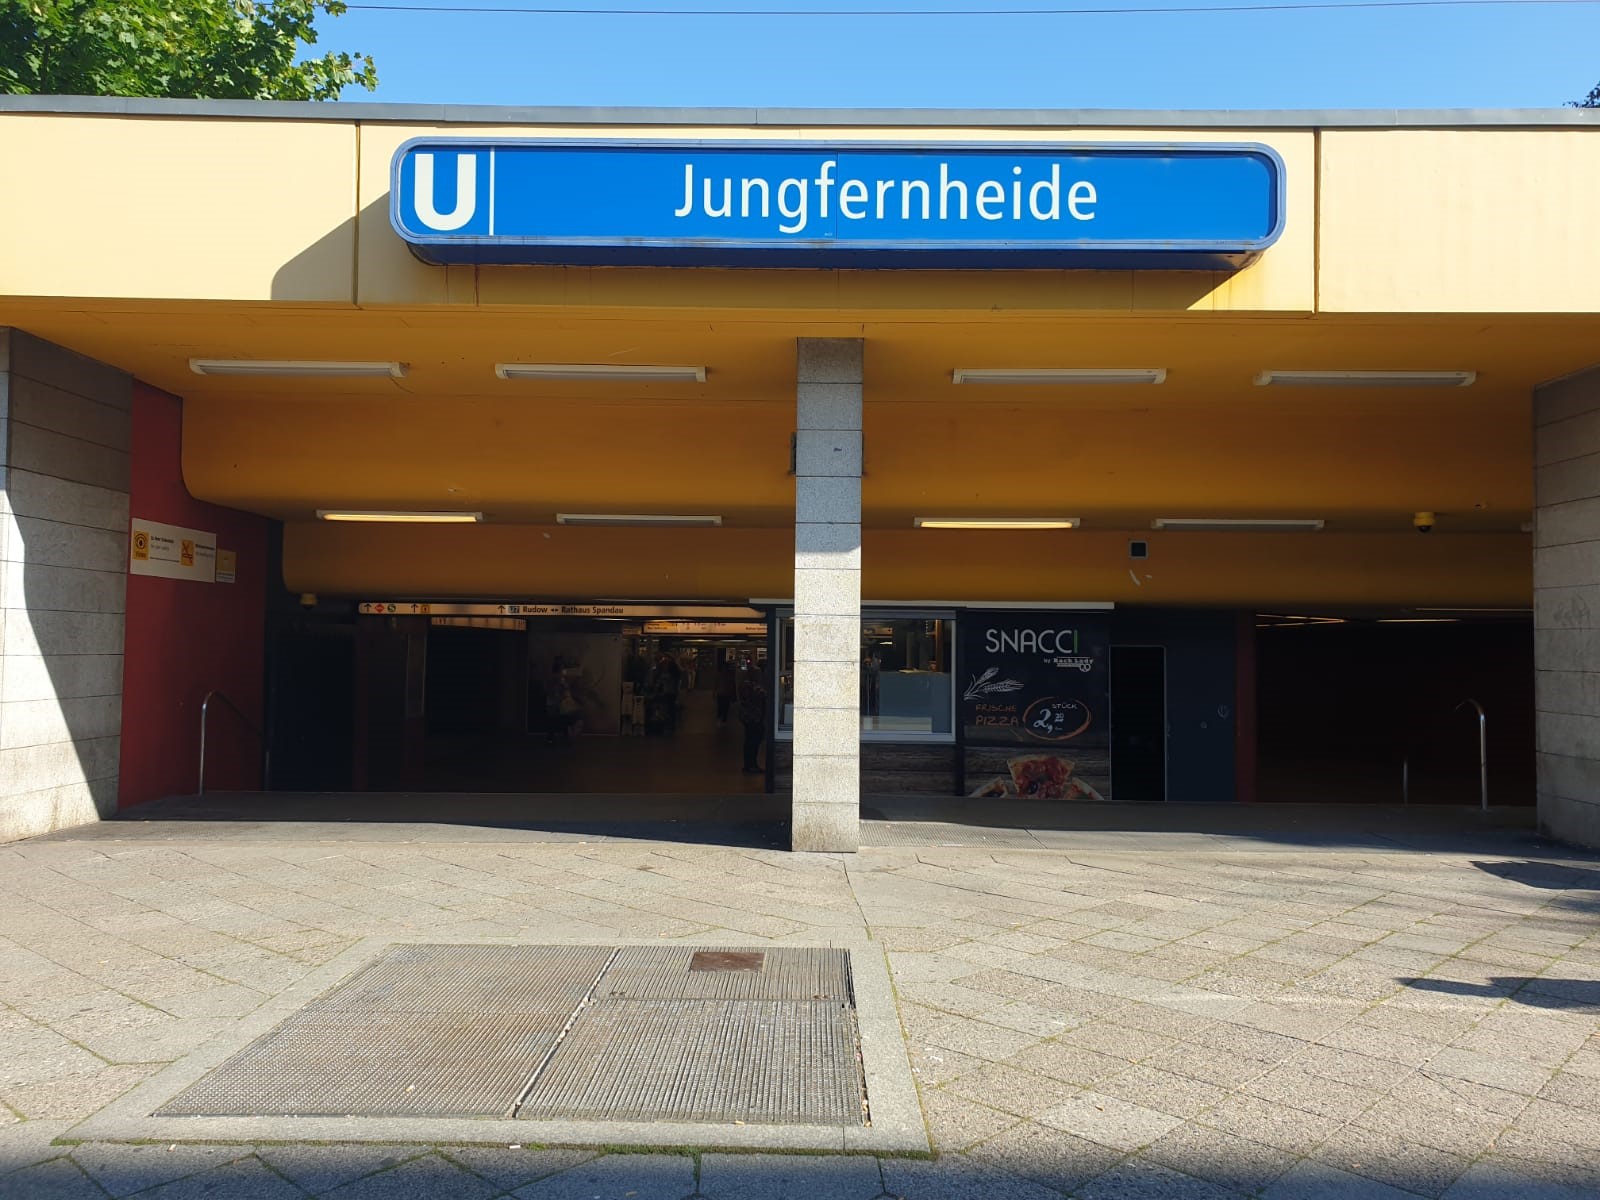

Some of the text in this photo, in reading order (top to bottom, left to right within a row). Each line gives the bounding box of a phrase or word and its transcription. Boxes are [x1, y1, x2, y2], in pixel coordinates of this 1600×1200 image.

[414, 153, 1098, 234] U Jungfernheide
[523, 605, 548, 614] Rudow
[561, 605, 591, 614] Rathaus
[592, 605, 624, 615] Spandau
[985, 628, 1078, 654] SNACCI
[975, 703, 1017, 713] FRISCHE
[975, 714, 1020, 726] PIZZA
